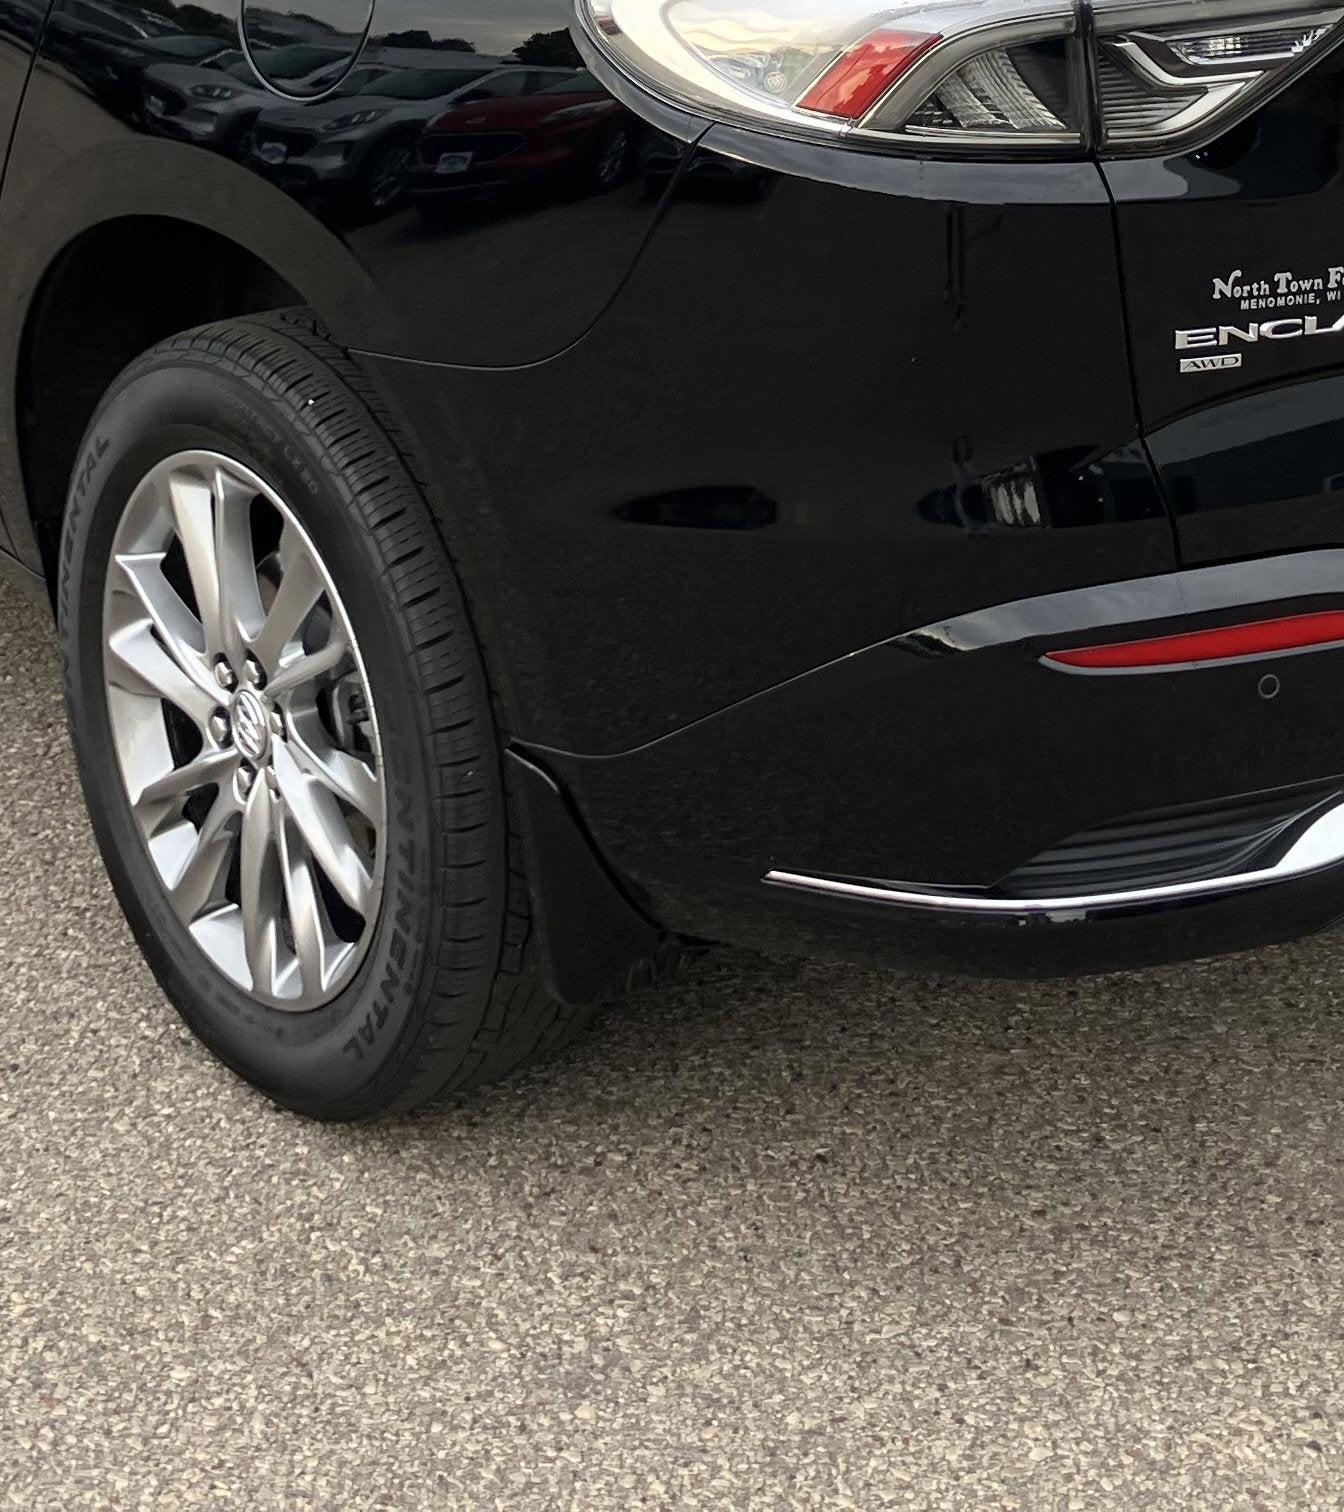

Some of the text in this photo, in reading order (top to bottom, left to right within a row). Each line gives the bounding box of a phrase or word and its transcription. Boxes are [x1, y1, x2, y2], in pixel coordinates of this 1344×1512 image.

[1212, 269, 1270, 300] North
[1274, 271, 1323, 295] Town
[1240, 290, 1342, 311] MENOMONIE, WI
[1184, 356, 1239, 369] AWD
[342, 744, 419, 1061] NTINENTAL
